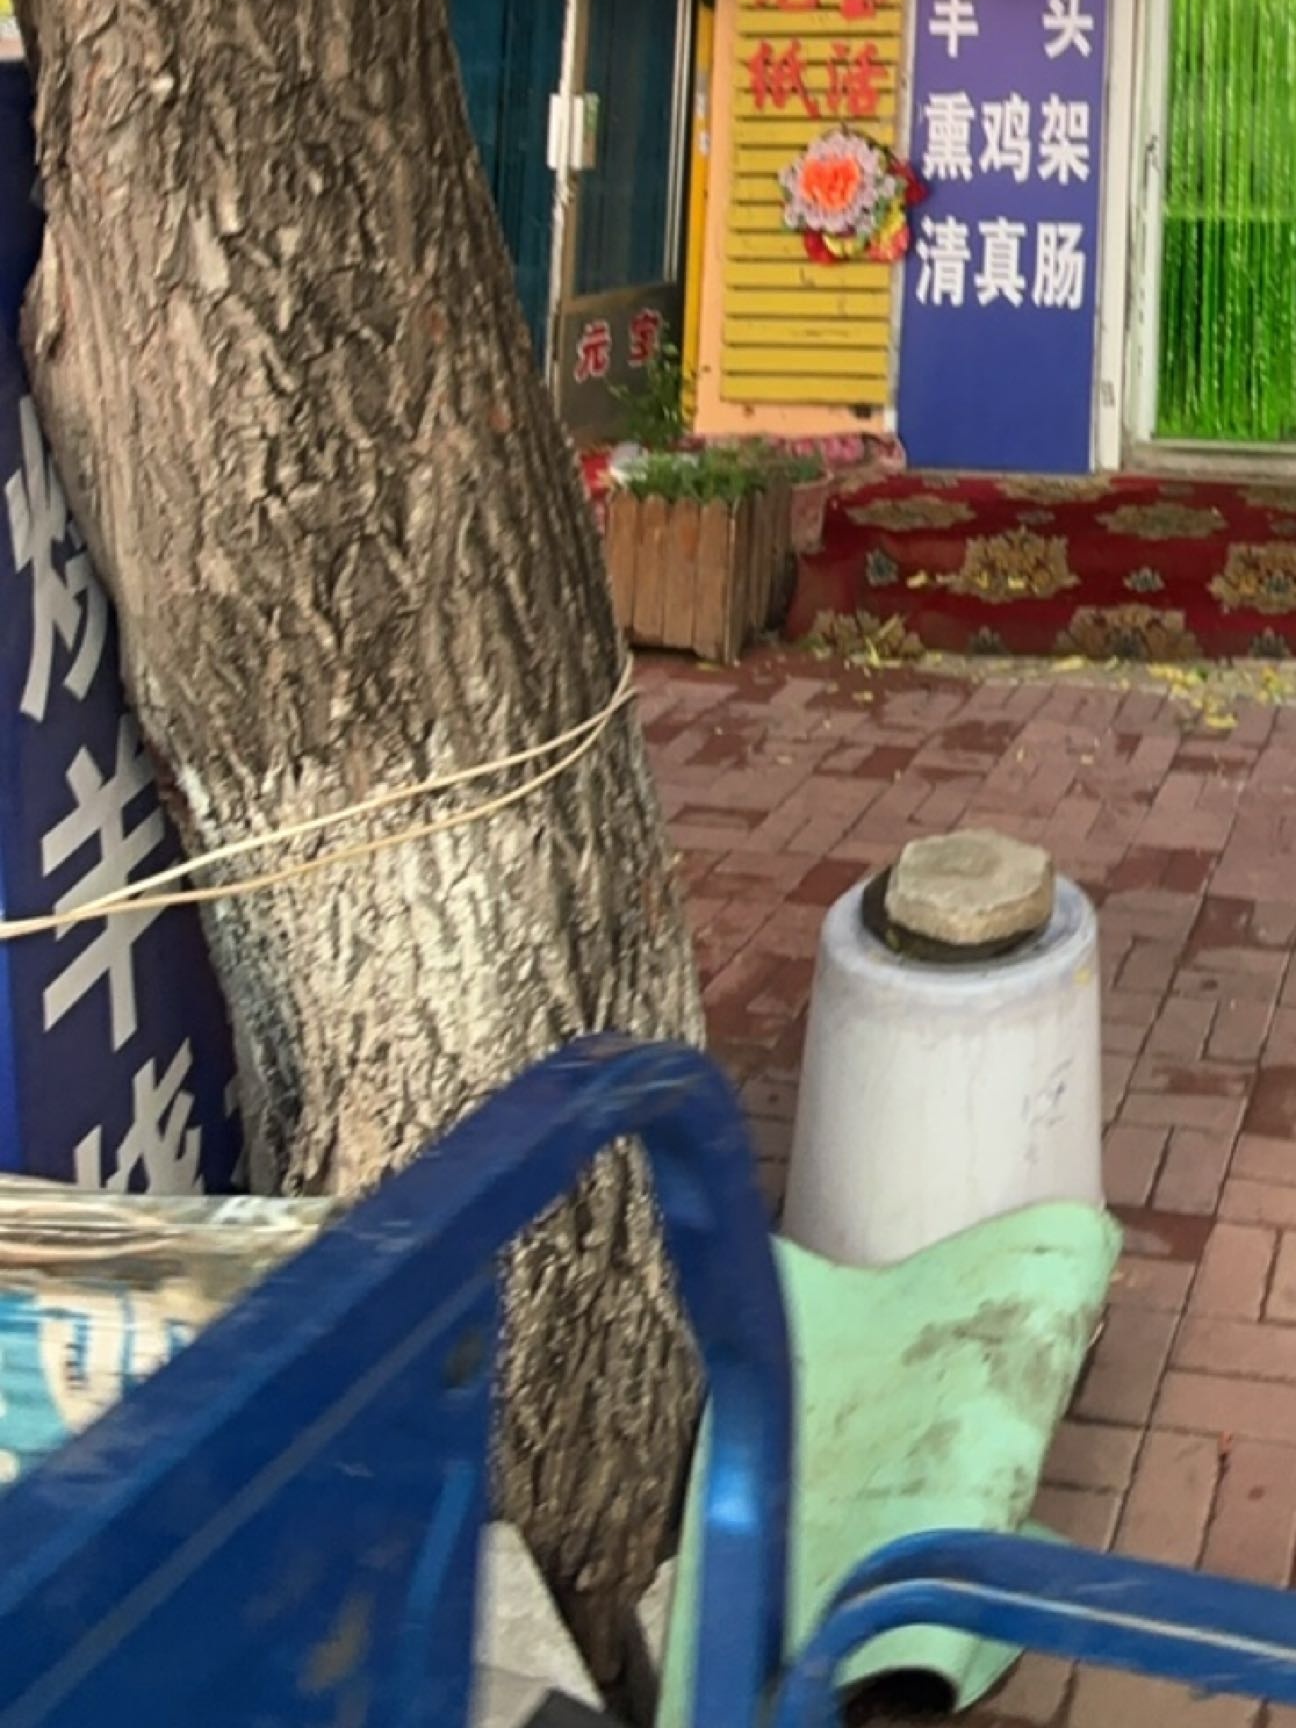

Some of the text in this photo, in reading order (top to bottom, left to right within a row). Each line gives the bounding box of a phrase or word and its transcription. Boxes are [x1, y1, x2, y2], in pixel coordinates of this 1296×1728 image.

[921, 92, 1091, 185] 熏鸡架
[915, 215, 1088, 310] 清真肠
